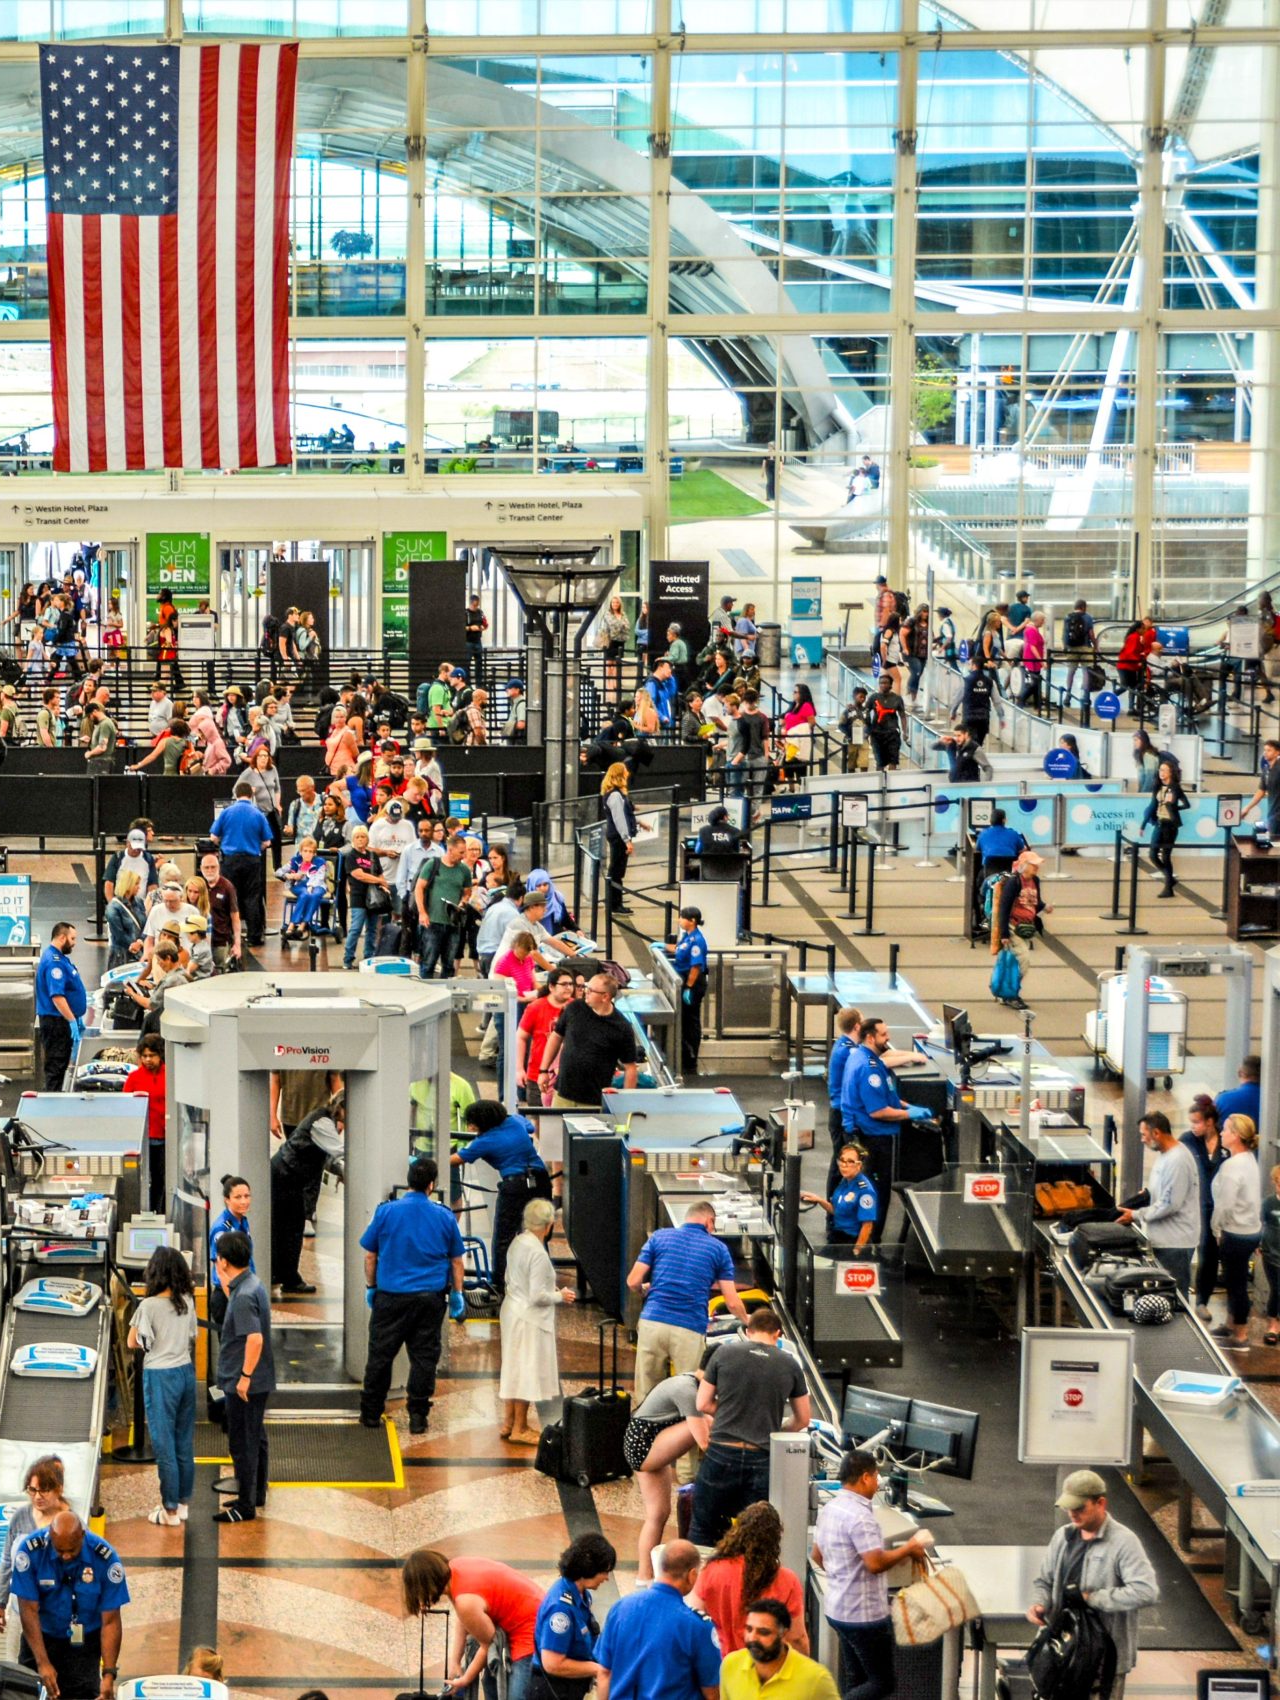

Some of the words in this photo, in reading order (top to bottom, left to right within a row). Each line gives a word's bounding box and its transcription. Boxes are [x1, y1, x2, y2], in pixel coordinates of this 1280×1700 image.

[64, 505, 85, 513] Hotel,
[88, 504, 108, 512] Plaza
[537, 502, 560, 510] Hotel,
[562, 501, 582, 509] Plaza
[159, 540, 196, 554] SUM
[396, 538, 432, 553] SUM
[160, 555, 195, 568] MER
[159, 569, 195, 583] DEN
[659, 575, 700, 583] Restricted
[665, 585, 694, 593] Access
[1091, 809, 1123, 819] Access
[1125, 810, 1134, 819] in
[693, 815, 704, 824] TSA
[1102, 821, 1128, 831] blink
[712, 832, 729, 842] TSA
[14, 896, 23, 905] IT
[15, 906, 23, 914] IT
[286, 1046, 330, 1054] ProVision
[1025, 1043, 1030, 1054] 8
[310, 1055, 329, 1063] ATD
[791, 1107, 797, 1120] 7
[973, 1184, 997, 1192] STOP
[847, 1273, 872, 1282] STOP
[1064, 1393, 1081, 1401] STOP
